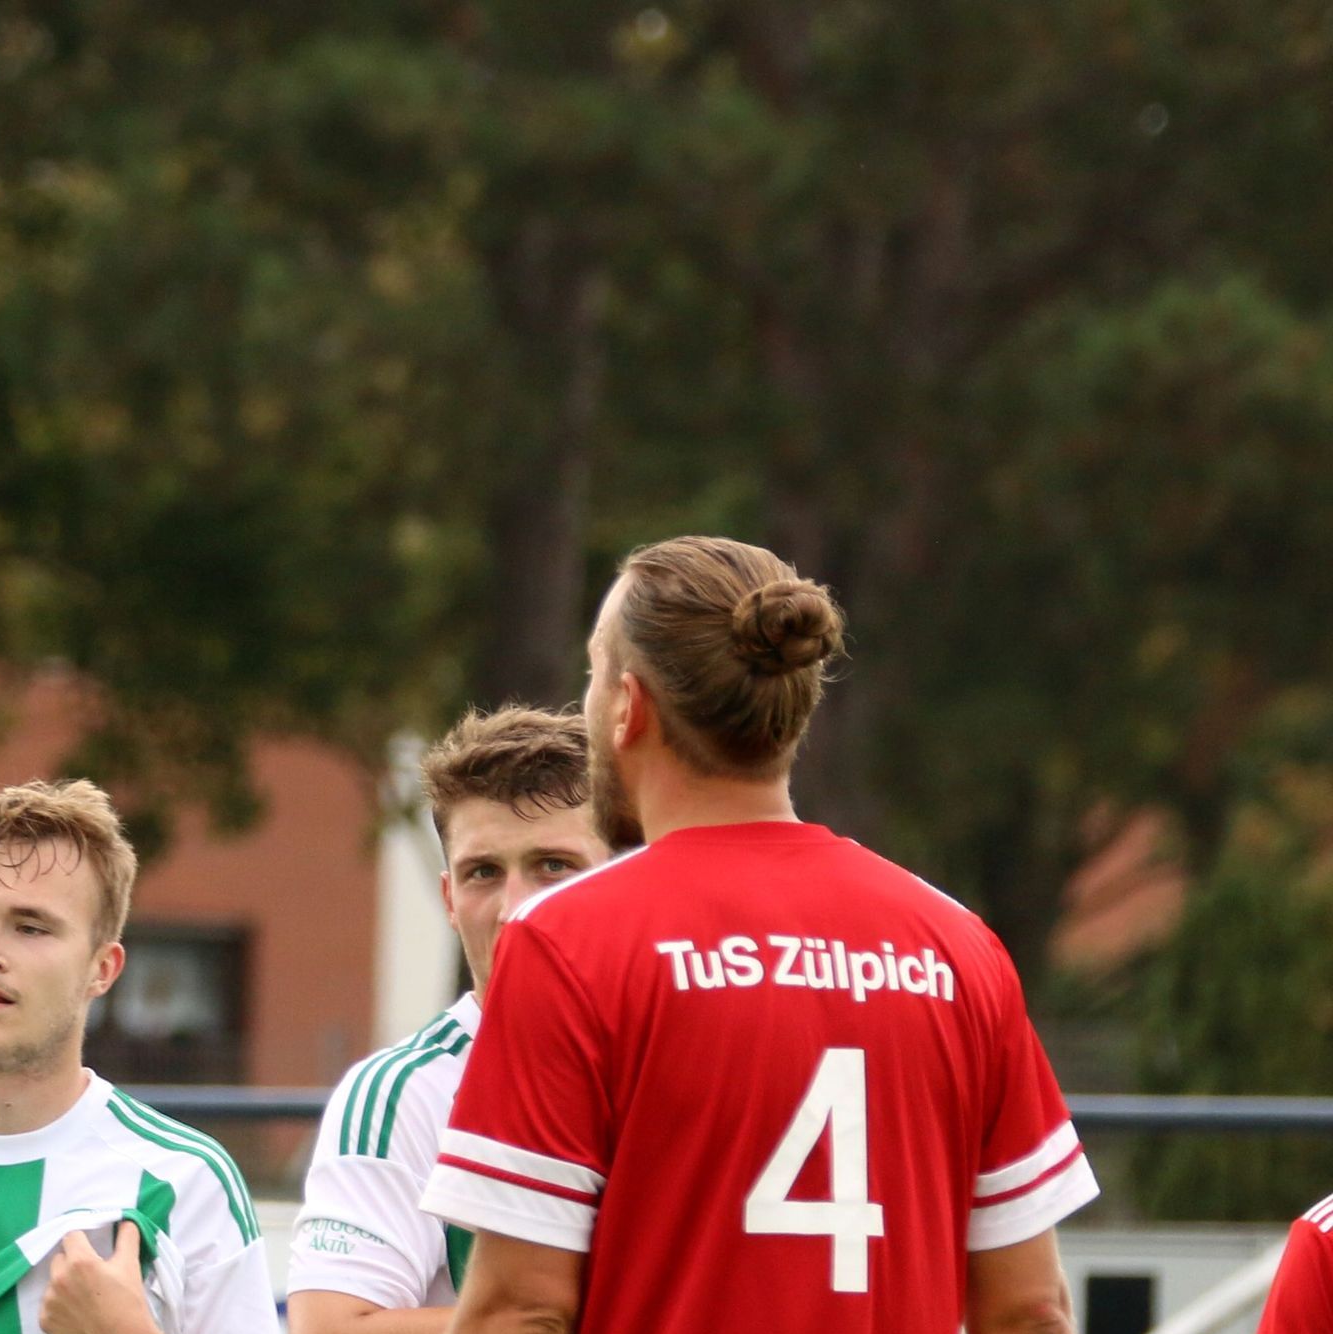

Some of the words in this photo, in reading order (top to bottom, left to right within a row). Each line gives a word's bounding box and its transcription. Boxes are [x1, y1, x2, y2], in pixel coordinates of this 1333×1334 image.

[656, 936, 764, 990] TuS
[767, 935, 955, 1002] Zülpich
[745, 1048, 884, 1292] 4
